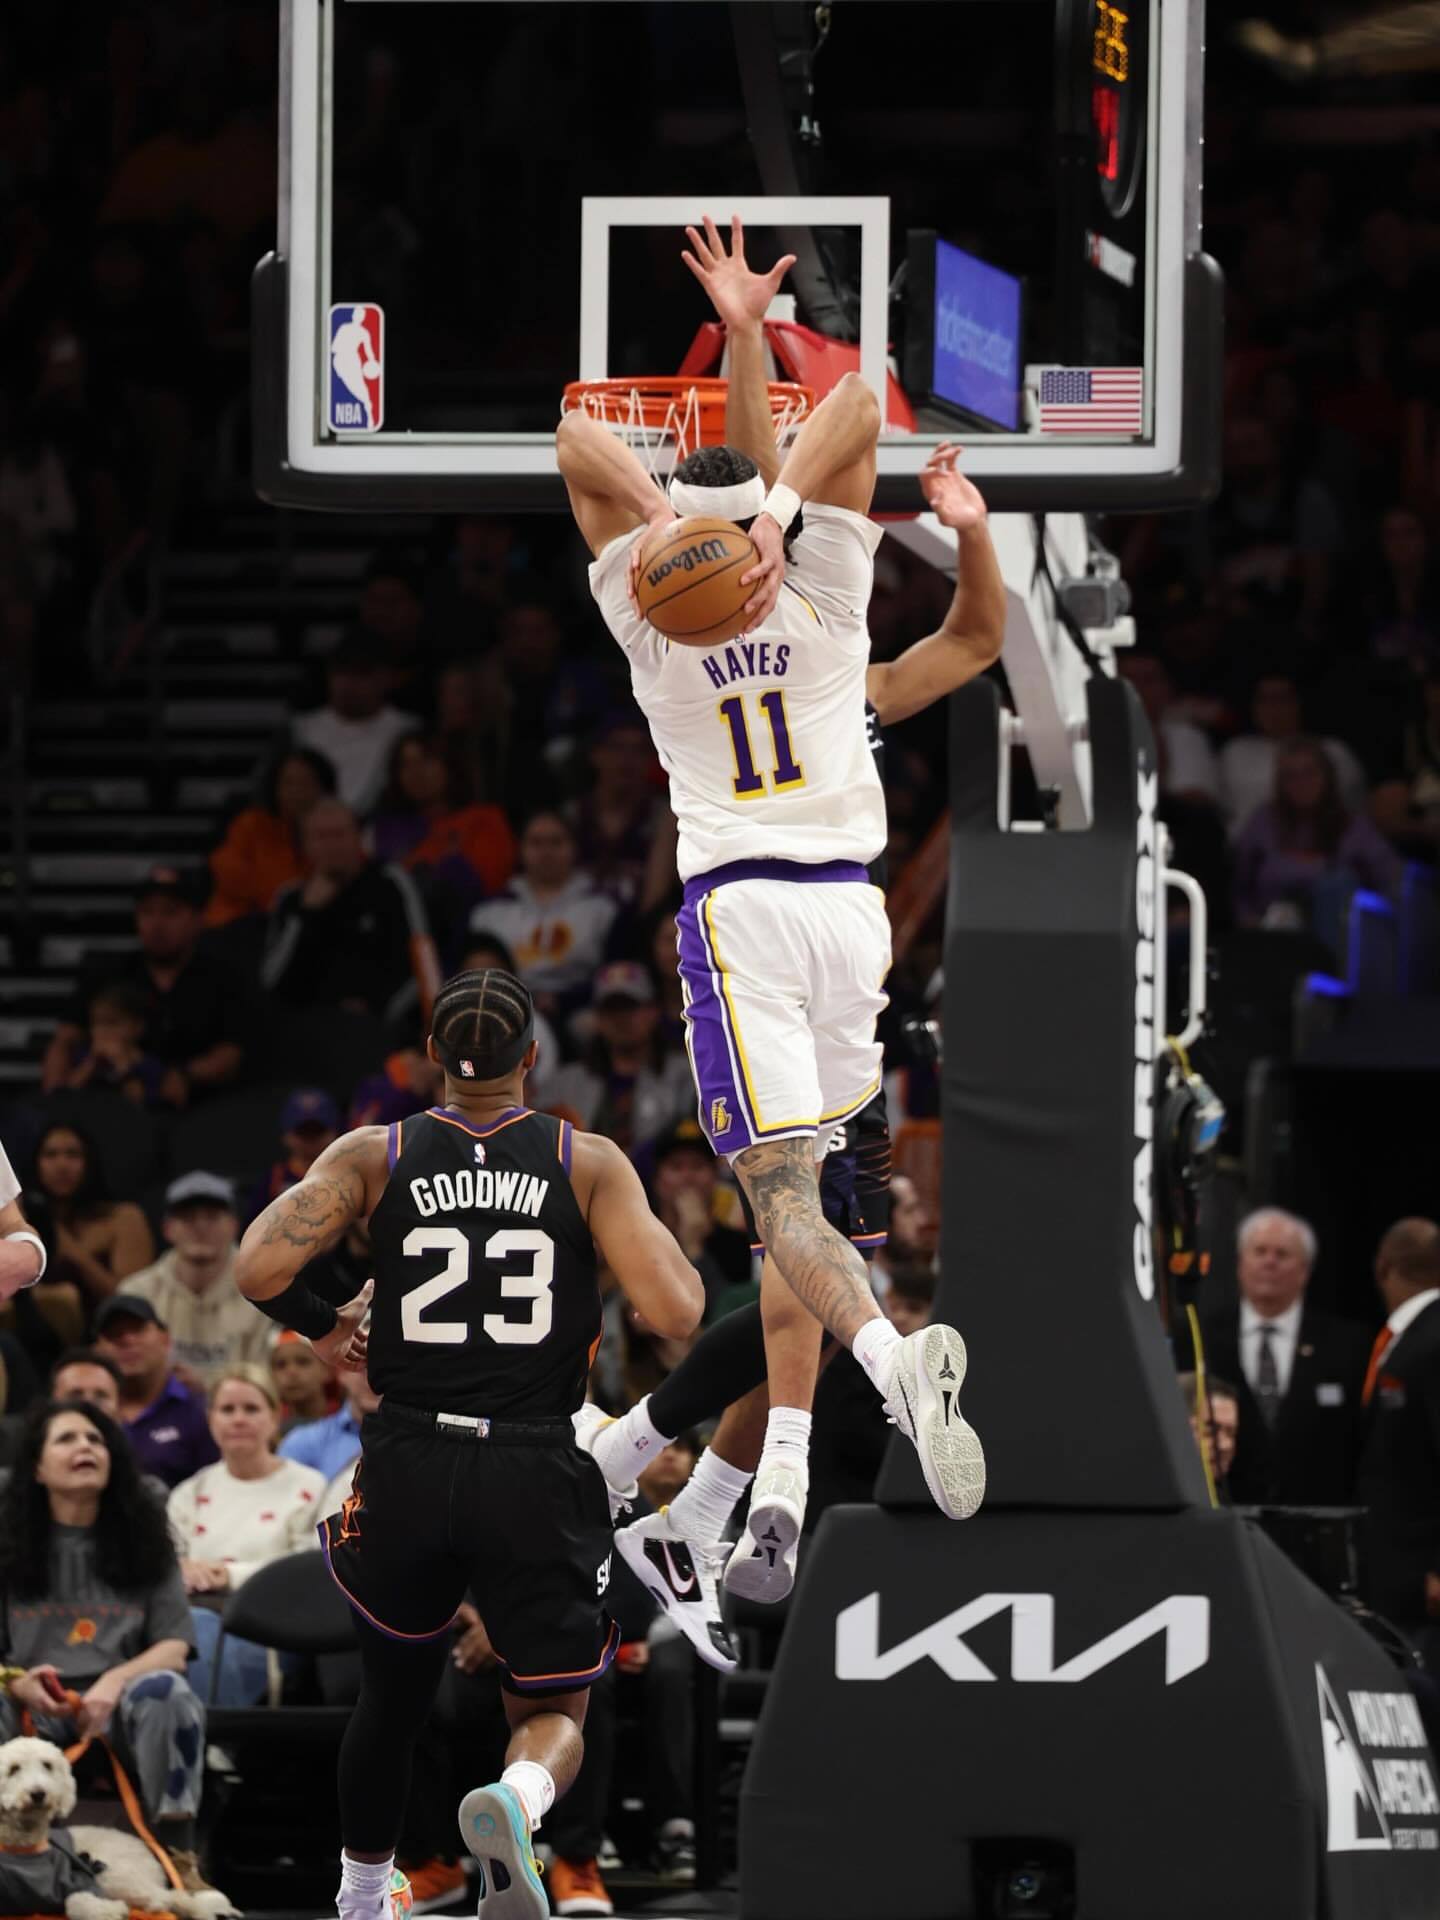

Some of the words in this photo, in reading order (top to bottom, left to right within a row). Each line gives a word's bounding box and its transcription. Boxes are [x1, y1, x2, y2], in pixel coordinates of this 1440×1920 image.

[335, 402, 362, 424] NBA
[647, 538, 729, 587] Wilson
[702, 643, 791, 690] HAYES
[716, 688, 807, 801] 11
[410, 1169, 549, 1218] GOODWIN
[401, 1227, 555, 1345] 23
